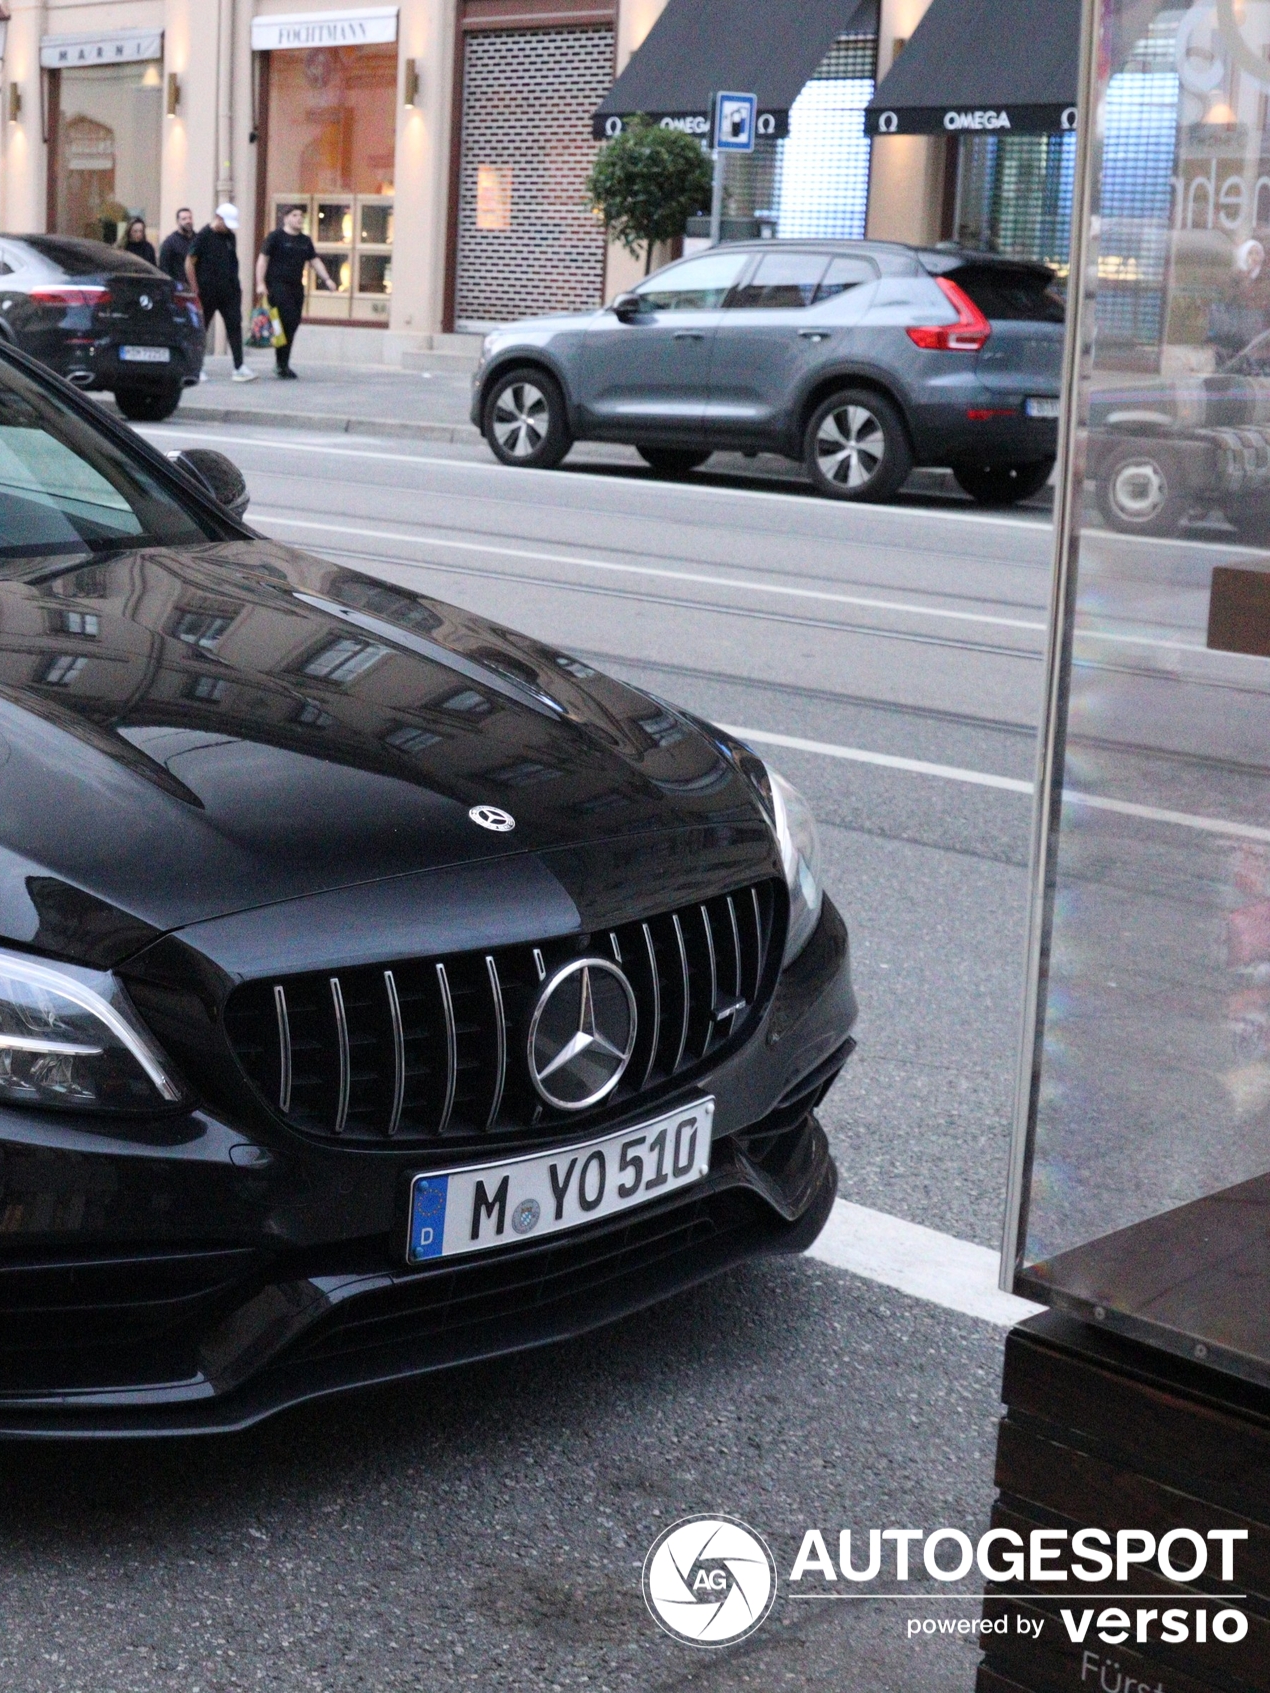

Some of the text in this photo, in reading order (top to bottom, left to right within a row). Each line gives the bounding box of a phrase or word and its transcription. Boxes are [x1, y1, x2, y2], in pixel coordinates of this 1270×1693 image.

[278, 21, 368, 45] FOCHTMANN
[59, 43, 141, 62] MARNI
[659, 116, 711, 134] OMEG
[943, 110, 1012, 131] OMEGA
[470, 1117, 698, 1241] M YO 510
[420, 1227, 434, 1246] D
